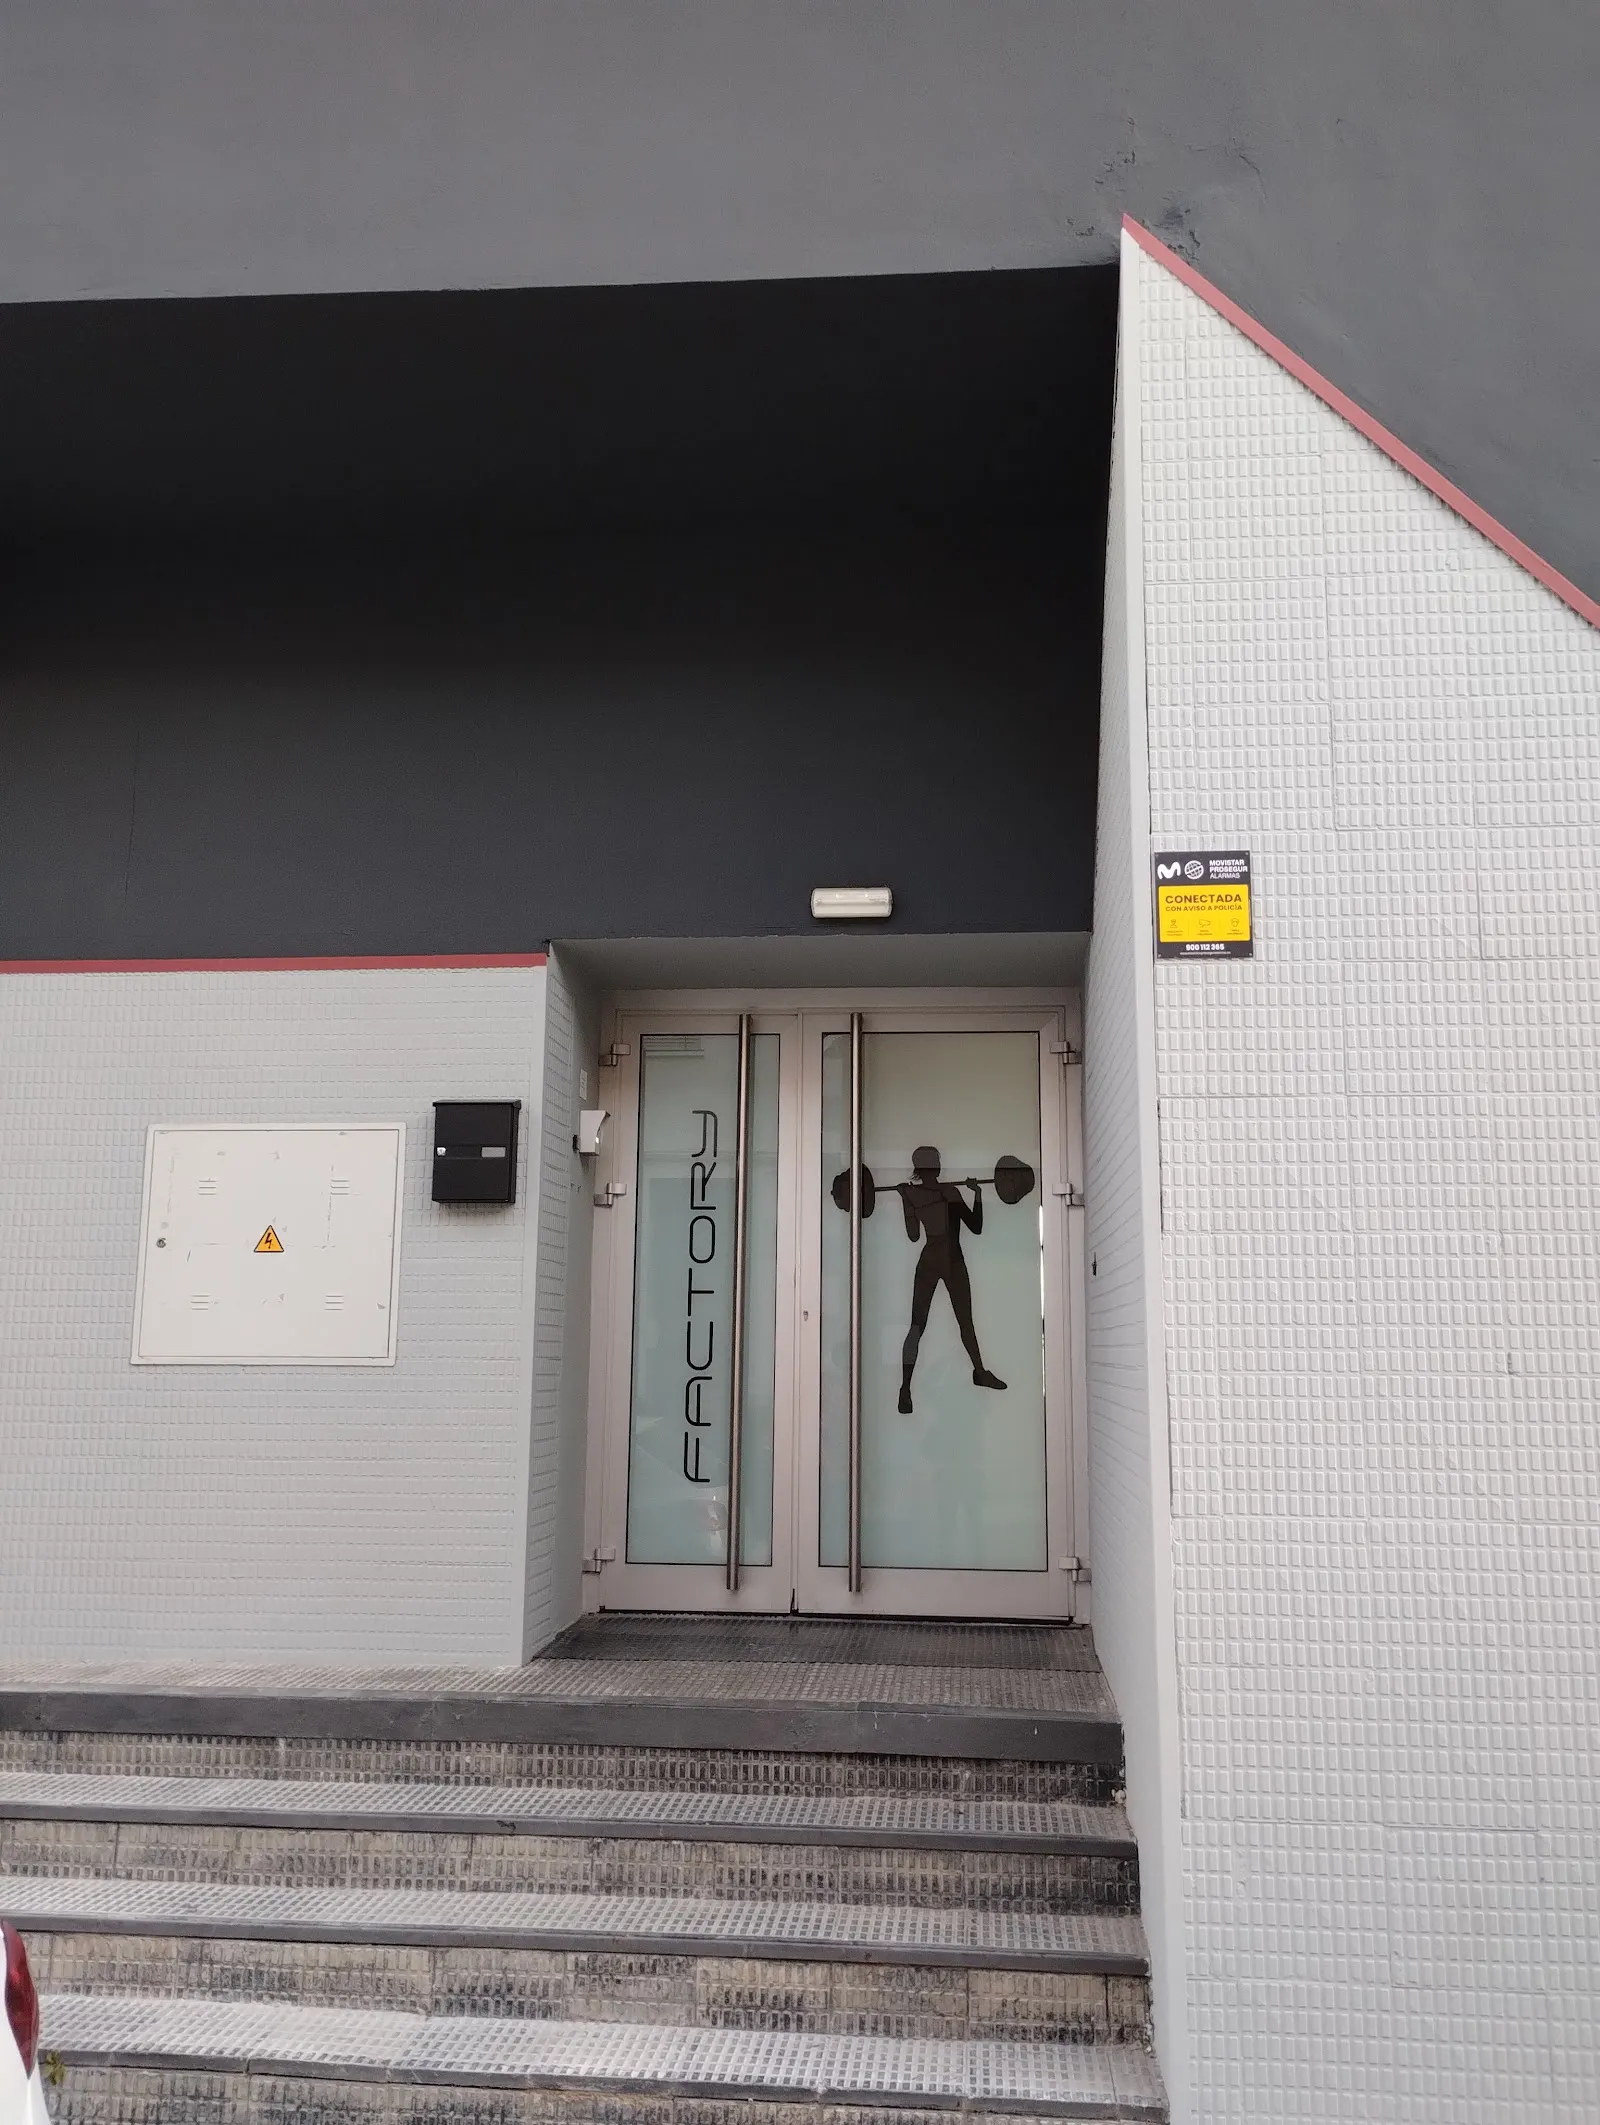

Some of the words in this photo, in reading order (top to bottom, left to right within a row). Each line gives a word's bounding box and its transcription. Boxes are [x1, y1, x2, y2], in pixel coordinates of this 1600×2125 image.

[1165, 894, 1242, 904] CONECTADA
[1214, 903, 1242, 911] POLICÍA
[683, 1109, 718, 1484] FACTORY
